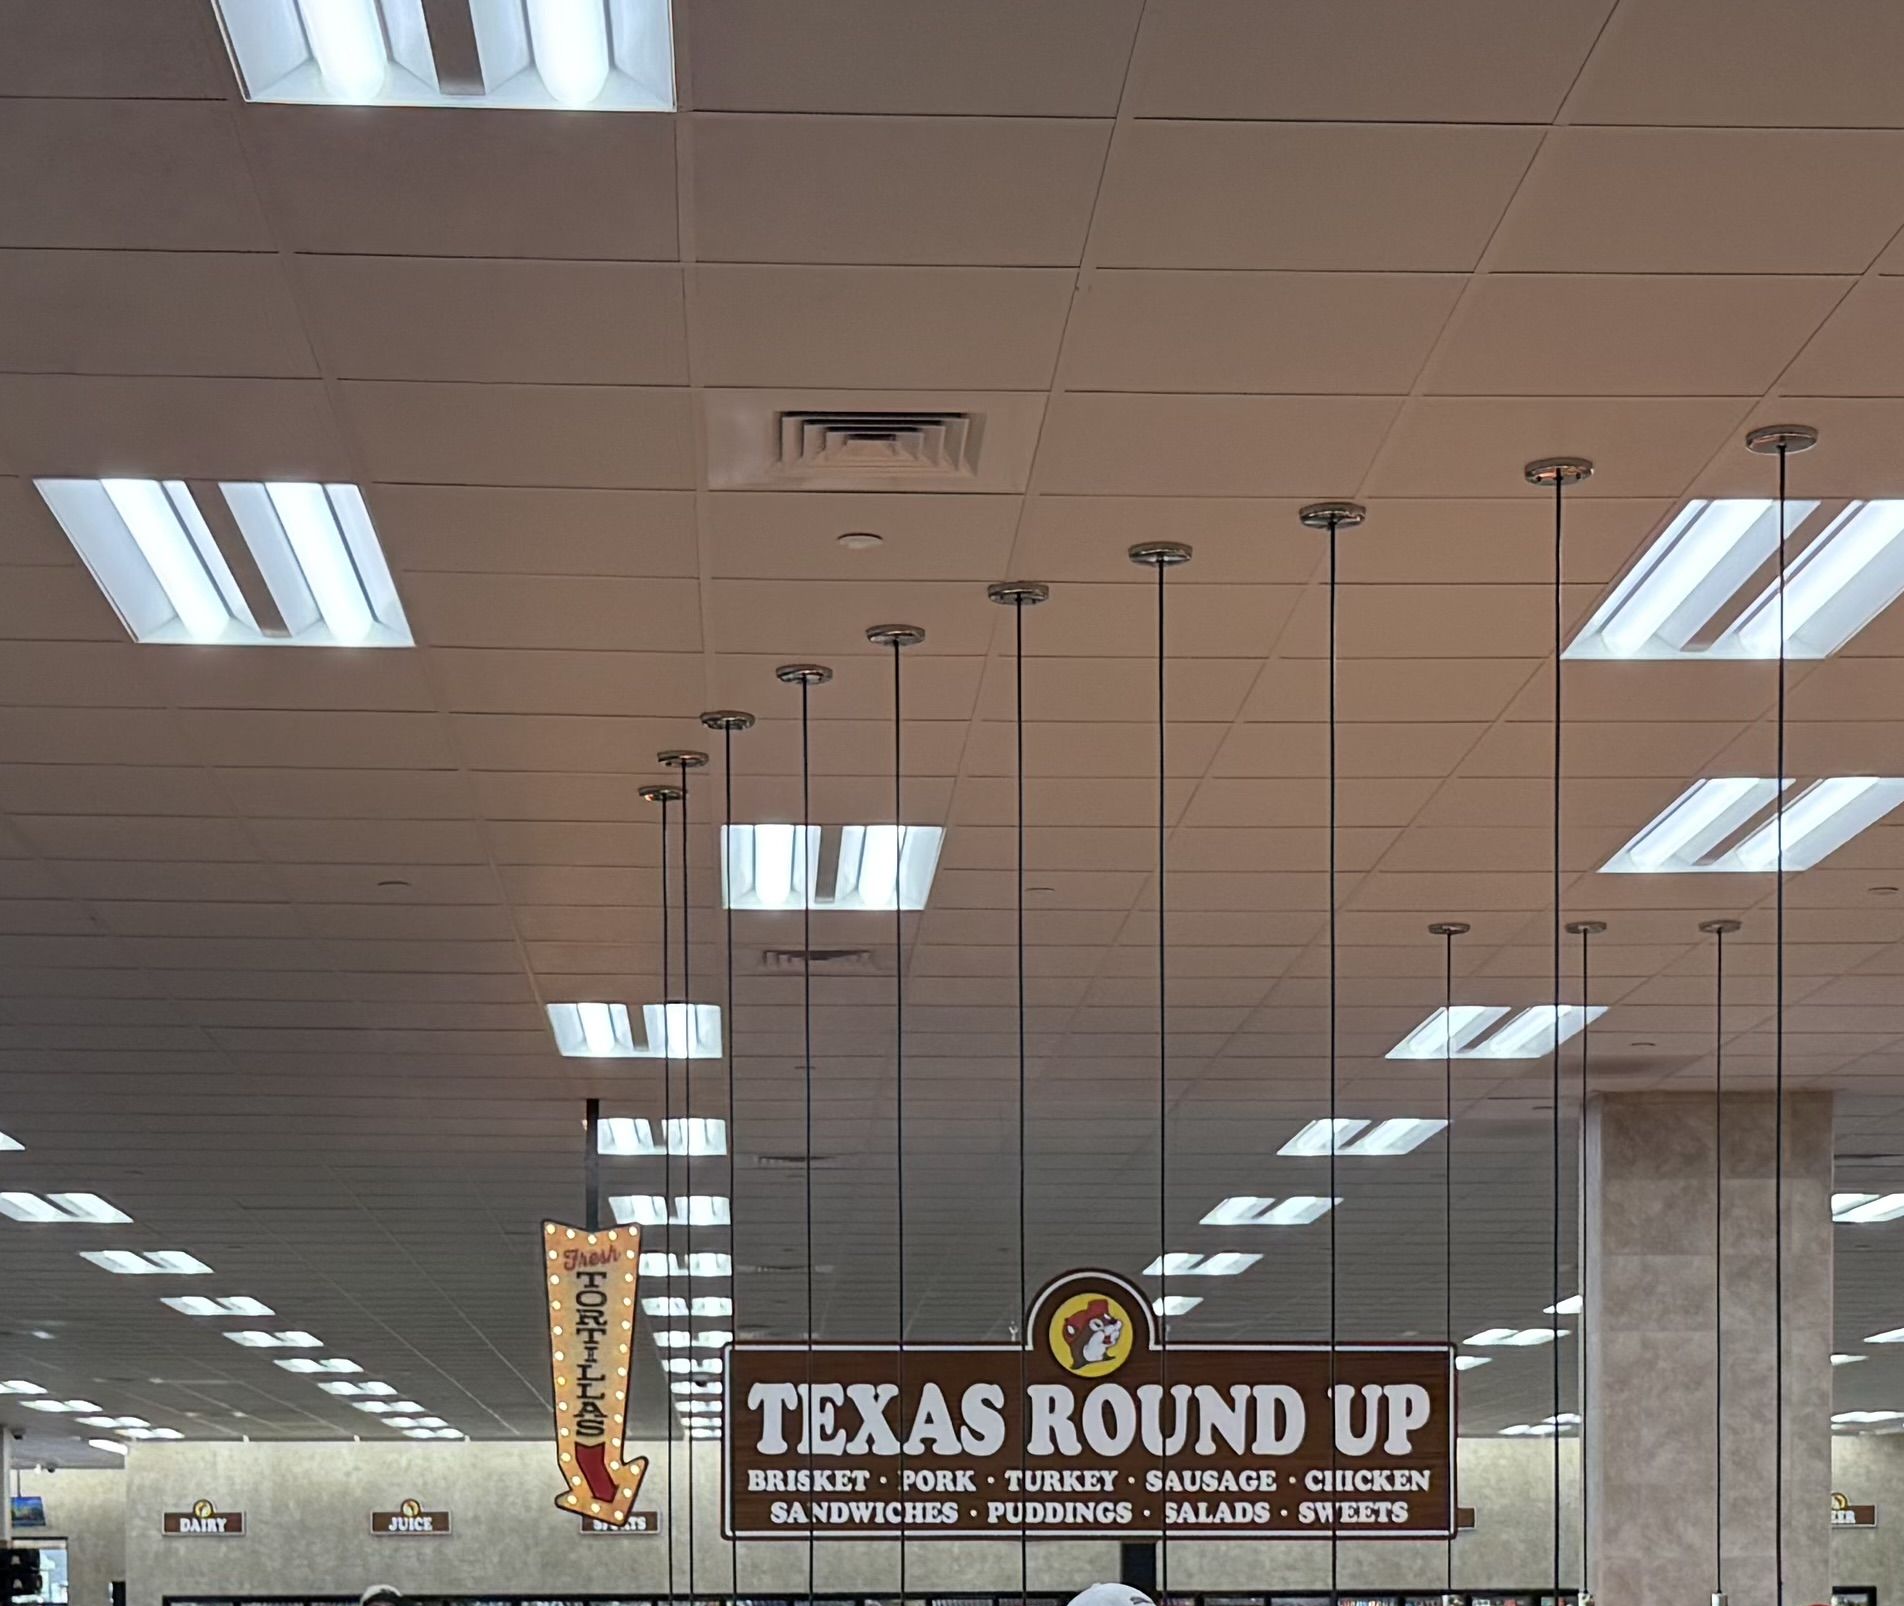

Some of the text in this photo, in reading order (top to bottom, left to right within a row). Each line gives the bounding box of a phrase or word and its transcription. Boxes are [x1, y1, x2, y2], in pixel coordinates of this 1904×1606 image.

[563, 1245, 621, 1271] Fresh
[573, 1271, 608, 1438] TORTILLAS
[747, 1381, 1431, 1457] TEXAS ROUND UP
[747, 1469, 1431, 1492] BRISKET PORK TURKEY SAUSAGE CHICKEN
[769, 1500, 1409, 1524] SANDWICHES PUDDINGS SALADS SWEETS
[179, 1517, 228, 1533] DAIRY
[388, 1517, 433, 1532] JUICE
